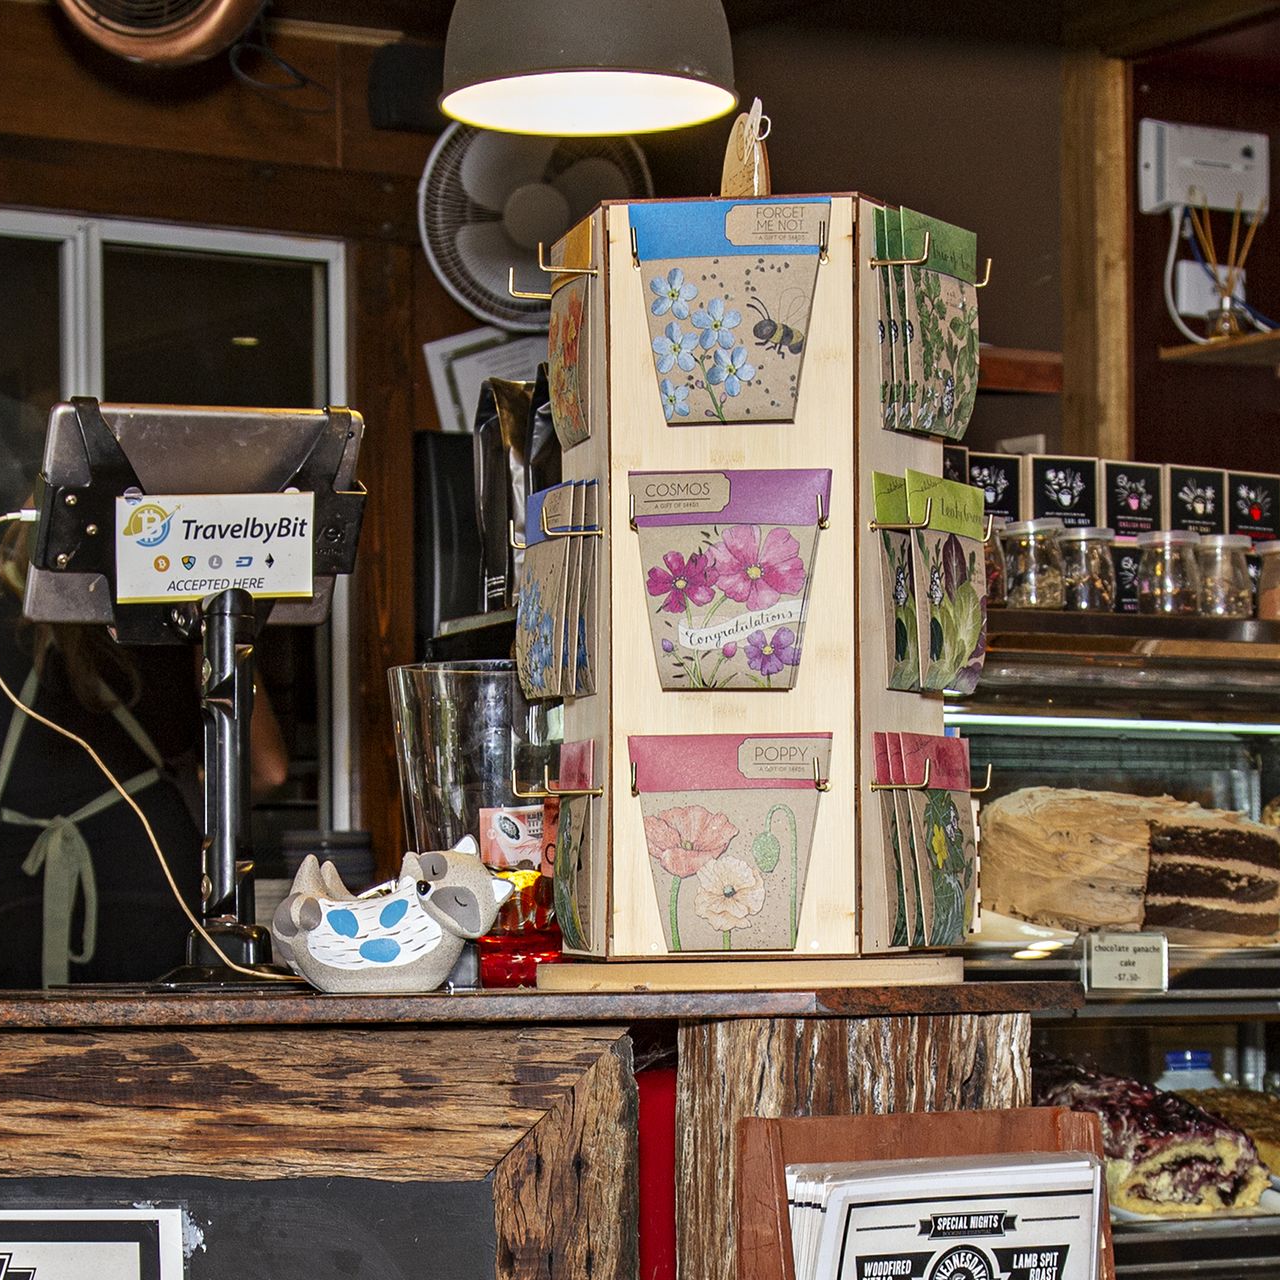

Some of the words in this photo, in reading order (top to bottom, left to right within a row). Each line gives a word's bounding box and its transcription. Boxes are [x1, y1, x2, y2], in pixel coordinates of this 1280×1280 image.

[756, 206, 805, 219] FORGET
[757, 220, 773, 231] ME
[778, 219, 804, 231] NOT
[645, 482, 710, 497] COSMOS
[182, 516, 308, 544] TravelbyBit
[167, 577, 230, 592] ACCEPTED
[233, 577, 265, 589] HERE
[685, 609, 793, 648] Congratulations
[755, 746, 808, 761] POPPY
[1094, 944, 1129, 952] chocolate
[1133, 945, 1160, 954] ganache
[1120, 959, 1136, 967] cake
[937, 1216, 967, 1231] SPECIAL
[970, 1214, 999, 1229] NIGHTS
[863, 1260, 912, 1276] WOODFIRED
[1013, 1254, 1038, 1269] LAMB
[1040, 1252, 1059, 1267] SPIT
